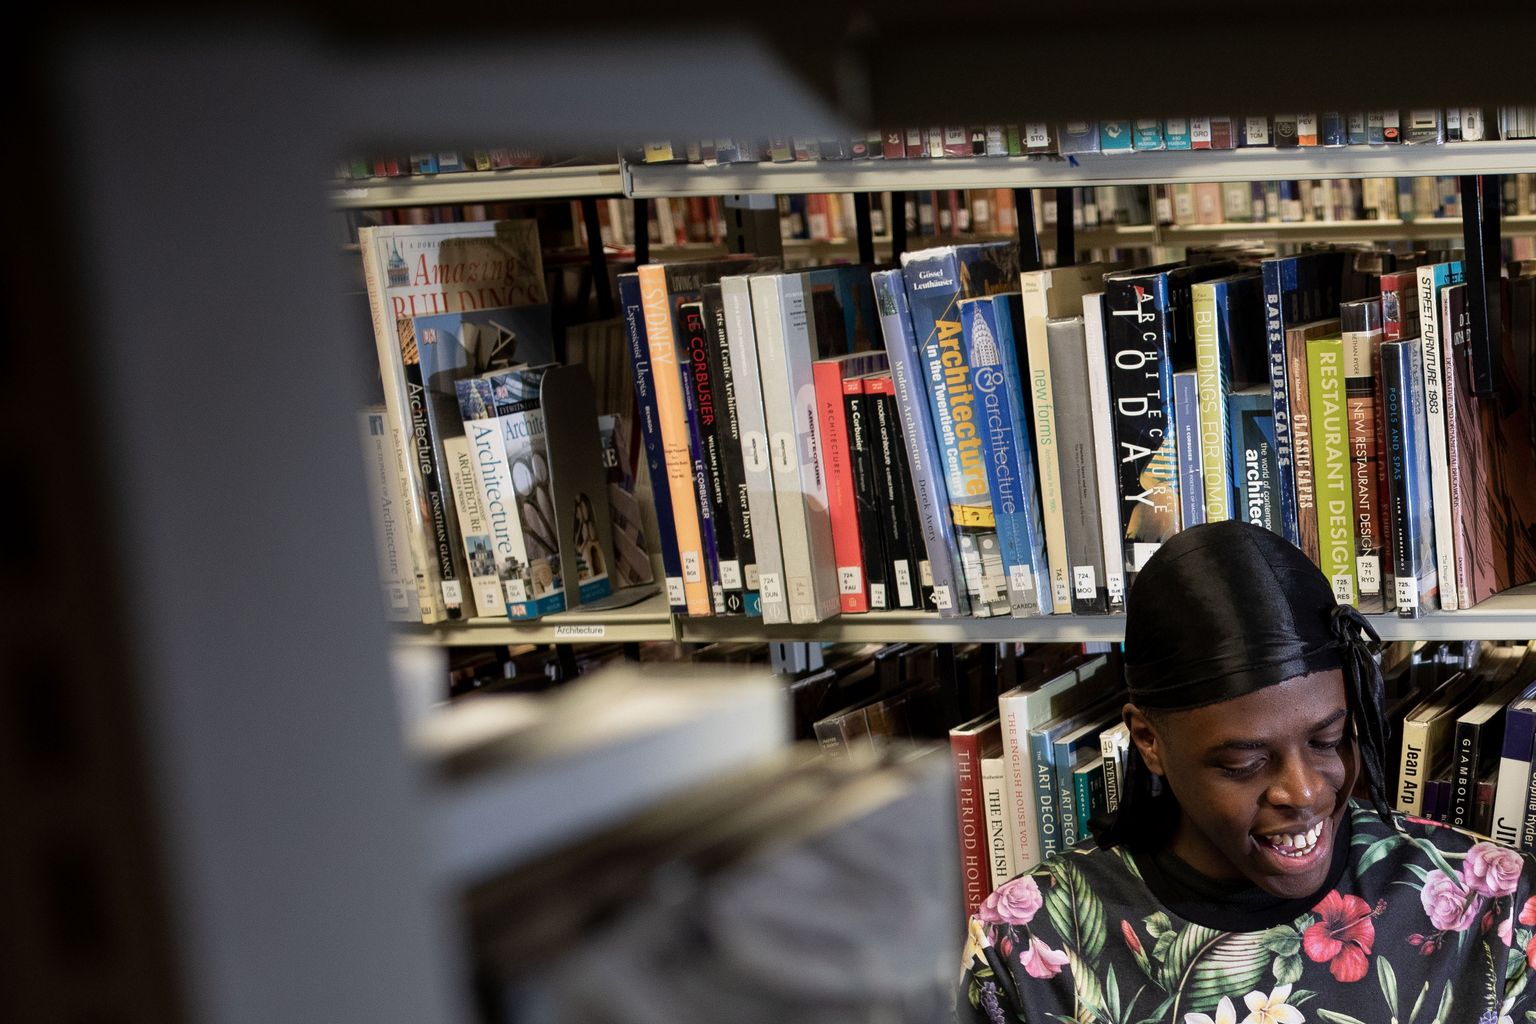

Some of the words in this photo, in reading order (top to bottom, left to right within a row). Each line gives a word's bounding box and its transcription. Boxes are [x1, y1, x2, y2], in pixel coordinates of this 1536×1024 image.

[1029, 134, 1045, 142] STO
[413, 252, 518, 288] Amazing
[913, 278, 953, 291] Leuthäuser
[918, 269, 944, 280] Gössel
[1421, 276, 1434, 322] STREET
[642, 286, 673, 365] SYDNEY
[929, 359, 941, 381] the
[1195, 310, 1218, 414] BUILDINGS
[1424, 322, 1439, 387] FURNITURE
[690, 338, 715, 426] CORBUSIER
[1034, 369, 1048, 401] new
[1428, 390, 1440, 415] 1983
[408, 382, 432, 475] Architecture
[934, 382, 955, 446] Twentieth
[935, 319, 988, 497] Architecture
[1035, 402, 1052, 446] forms
[1319, 351, 1347, 492] RESTAURANT
[1353, 402, 1366, 431] NEW
[1202, 420, 1220, 459] FOR
[1293, 413, 1311, 467] CLASSIC
[457, 451, 481, 533] ARCHITECTURE
[472, 424, 513, 555] Architecture
[1297, 469, 1314, 510] CAFES
[1355, 436, 1370, 511] RESTAURANT
[1327, 500, 1351, 577] DESIGN
[764, 590, 779, 598] DUN
[1360, 576, 1376, 584] RYD
[556, 625, 604, 636] Architecture
[957, 750, 972, 782] THE
[1038, 764, 1051, 792] ART
[1405, 744, 1422, 778] Jean
[988, 788, 1001, 818] THE
[1061, 789, 1072, 811] ART
[1402, 780, 1418, 805] Arp
[960, 786, 978, 851] PERIOD
[1040, 794, 1056, 835] DECO
[991, 819, 1008, 878] ENGLISH
